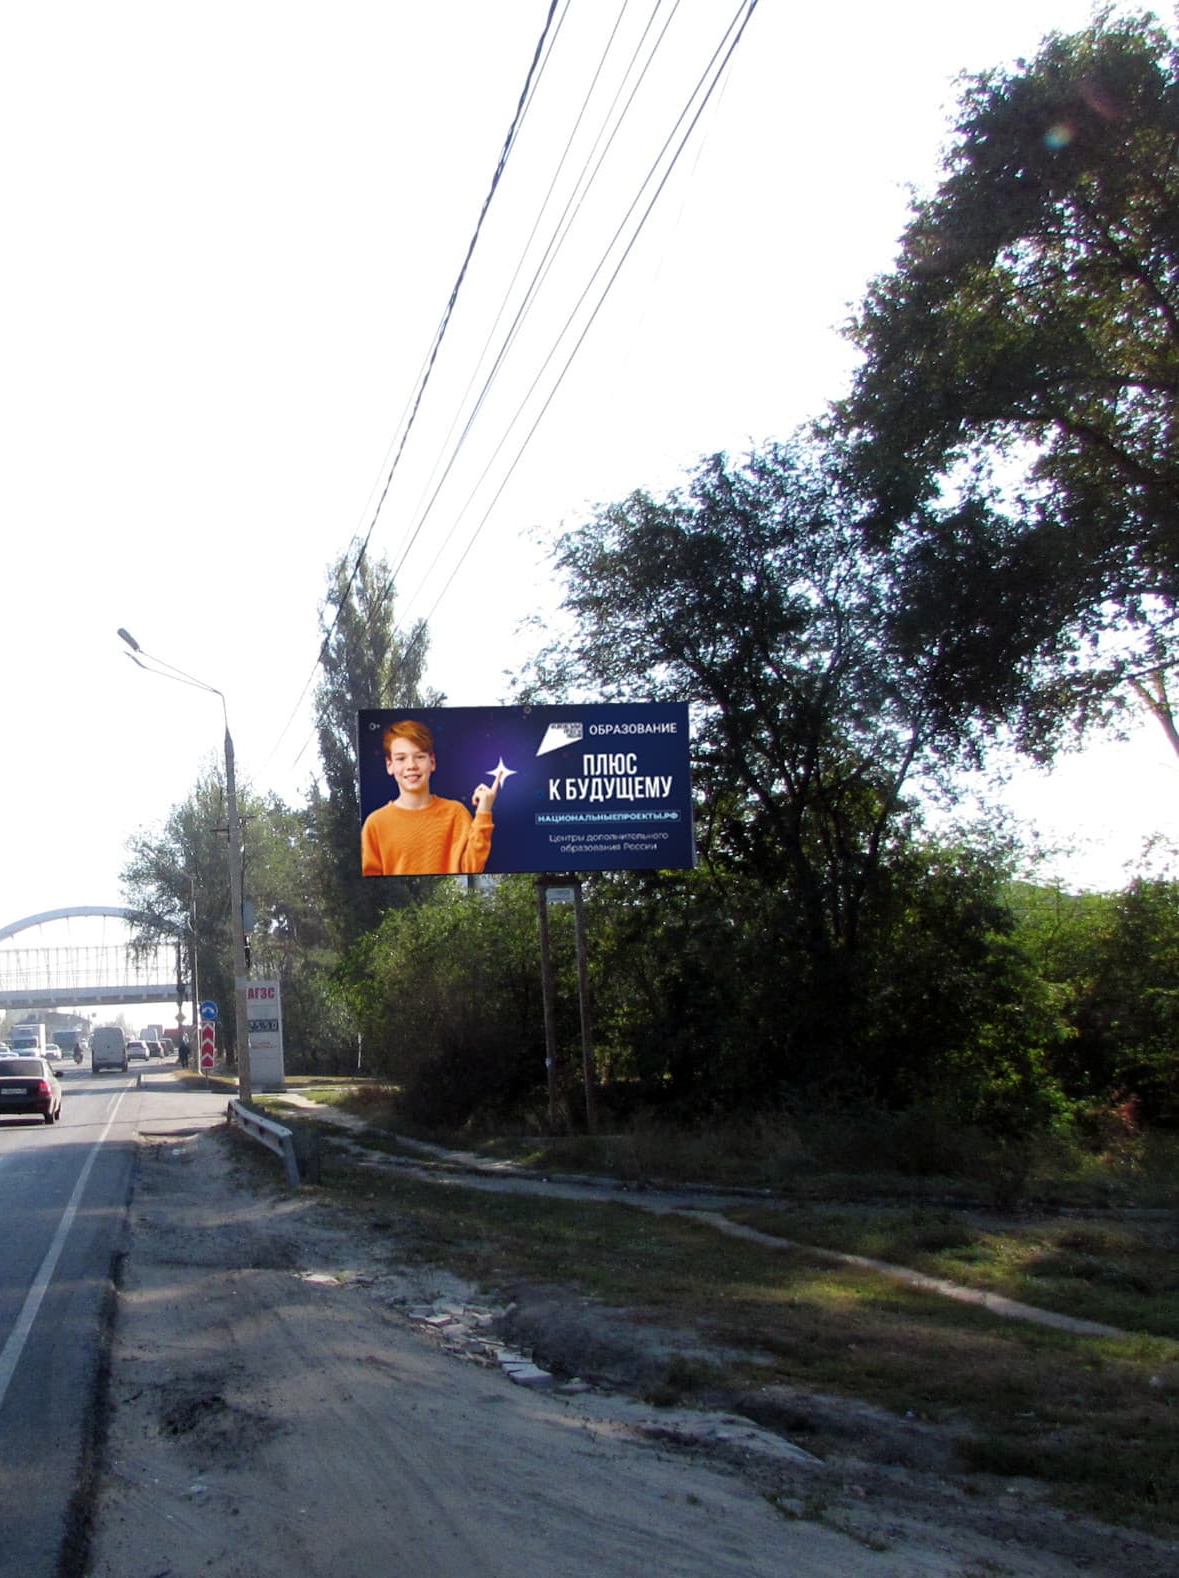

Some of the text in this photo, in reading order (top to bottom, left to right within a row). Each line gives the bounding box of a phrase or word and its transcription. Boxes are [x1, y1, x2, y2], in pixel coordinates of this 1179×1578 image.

[589, 722, 678, 736] ОБРАЗОВАНИЕ
[583, 753, 638, 776] ПЛЮС
[549, 775, 673, 803] К БУДУЩЕМУ
[549, 833, 585, 843] Центры
[623, 842, 658, 851] России
[248, 987, 275, 999] АГЗС
